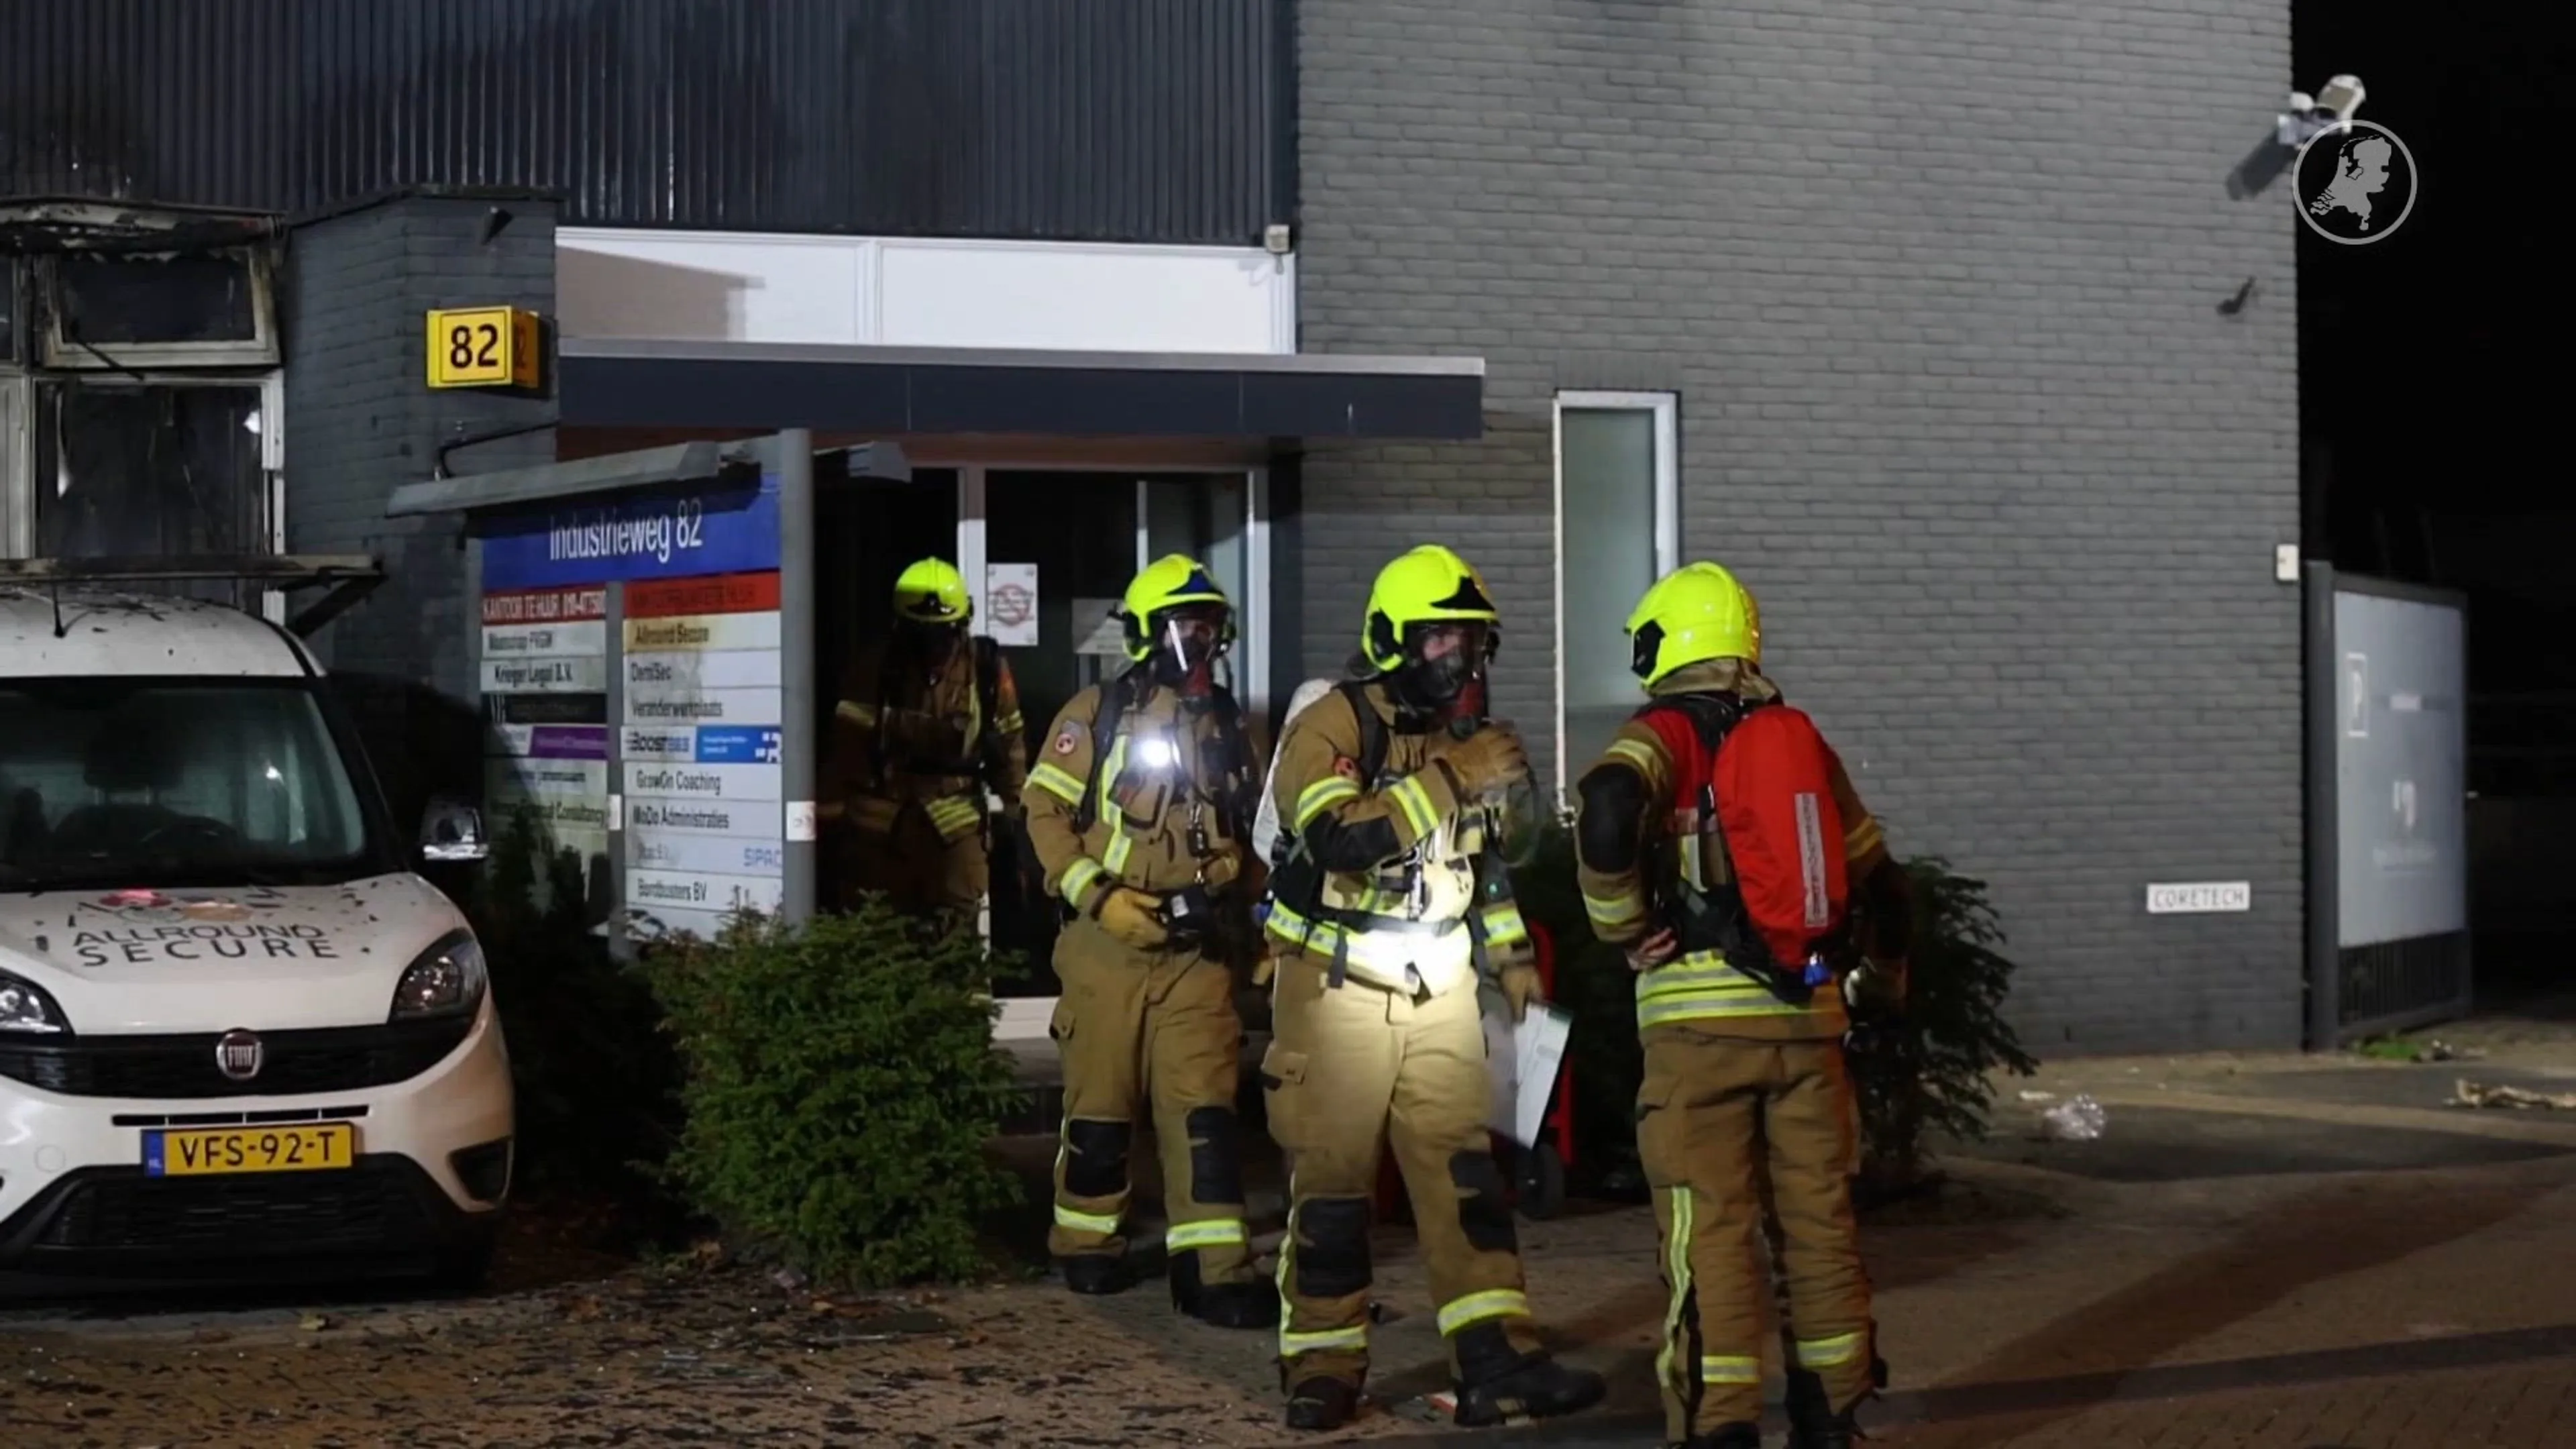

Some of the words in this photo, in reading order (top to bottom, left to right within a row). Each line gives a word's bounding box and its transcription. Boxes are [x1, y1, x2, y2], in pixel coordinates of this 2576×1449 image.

[450, 323, 498, 369] 82
[550, 507, 671, 564] Industrieweg
[676, 498, 702, 549] 82
[676, 770, 721, 796] Coaching
[74, 924, 325, 947] ALLROUND
[76, 939, 340, 967] SECURE
[227, 1045, 254, 1067] FIAT
[179, 1131, 335, 1168] VFS-92-T
